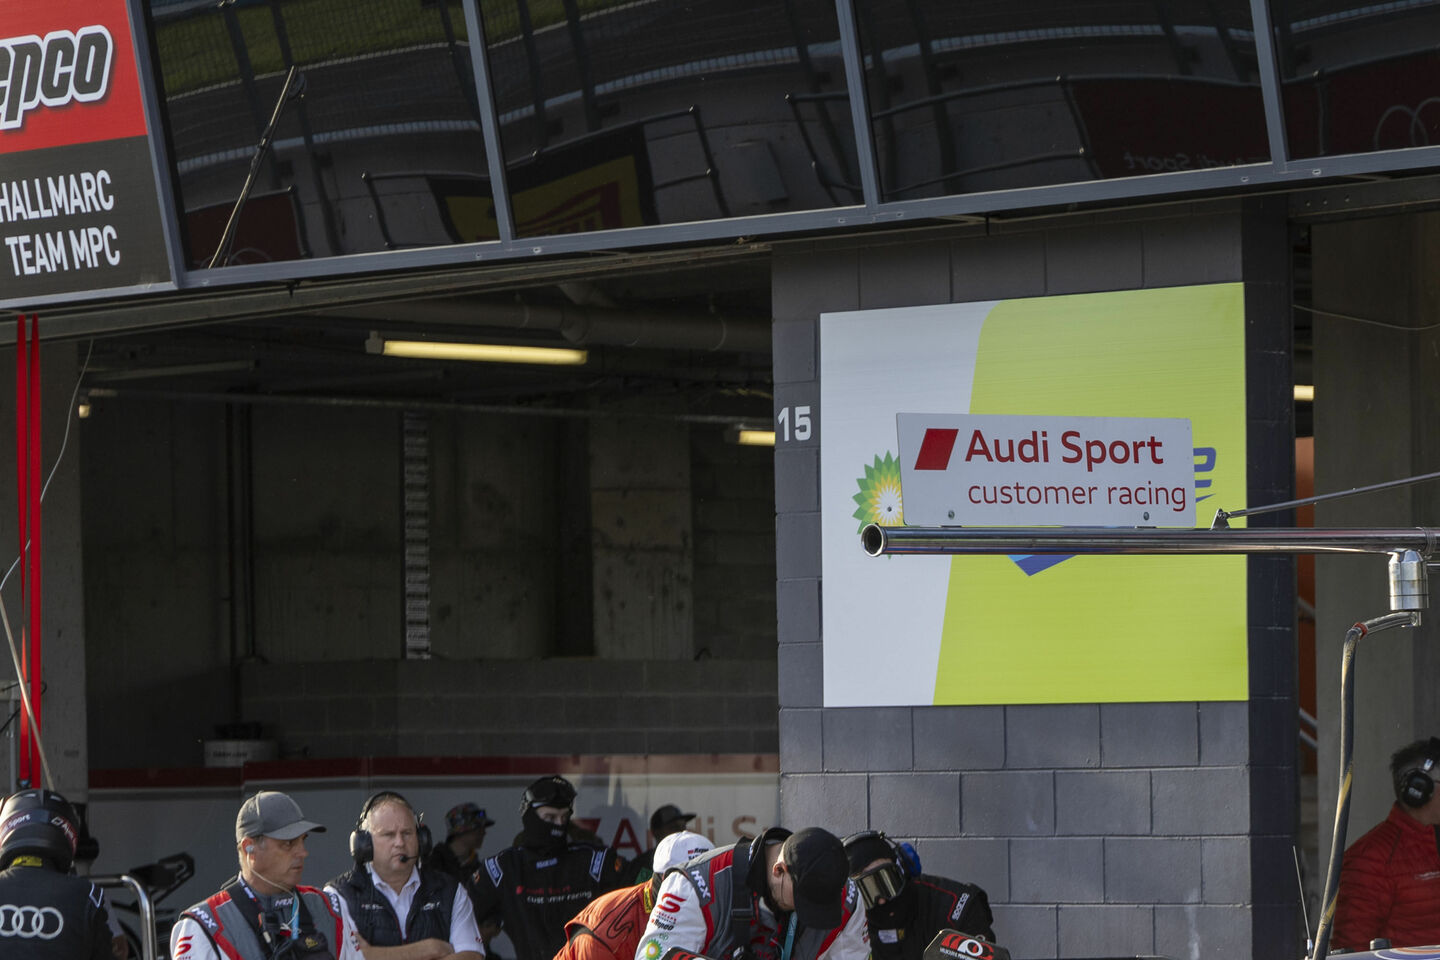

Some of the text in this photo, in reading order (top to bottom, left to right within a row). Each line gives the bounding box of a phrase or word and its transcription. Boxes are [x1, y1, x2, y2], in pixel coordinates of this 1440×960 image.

[5, 225, 121, 276] TEAM MPC
[777, 406, 812, 442] 15
[965, 430, 1049, 463] Audi
[1061, 430, 1165, 472] Sport
[968, 481, 1187, 512] customer racing
[691, 870, 711, 899] HRX
[191, 907, 218, 929] HRX
